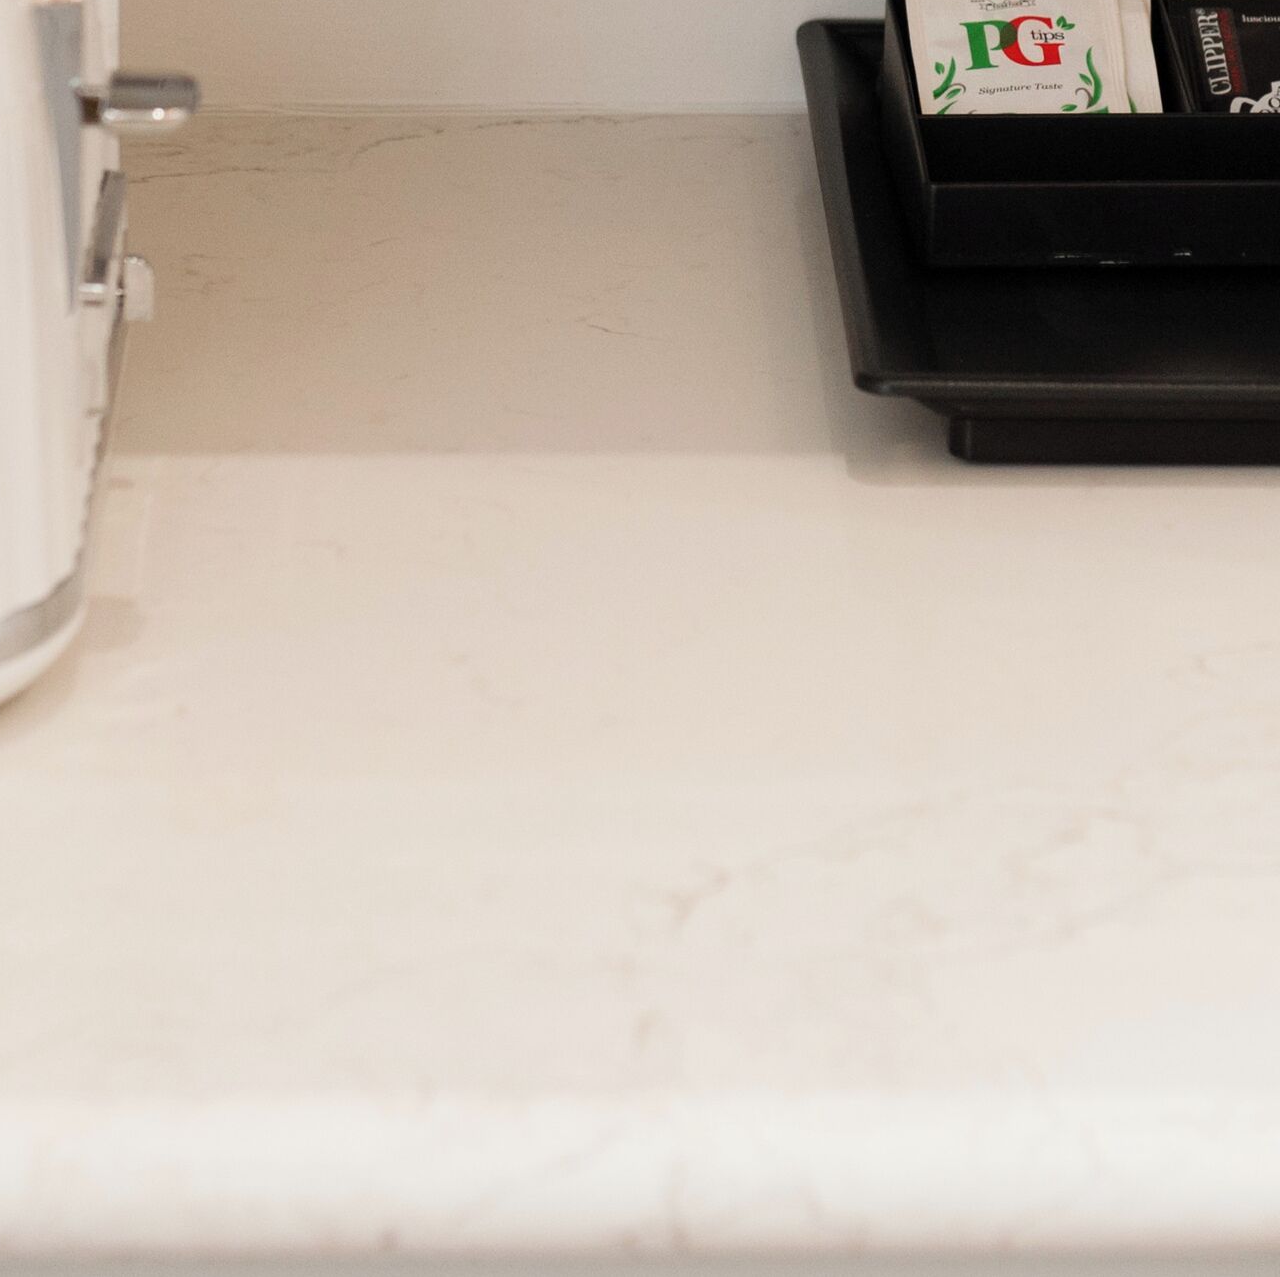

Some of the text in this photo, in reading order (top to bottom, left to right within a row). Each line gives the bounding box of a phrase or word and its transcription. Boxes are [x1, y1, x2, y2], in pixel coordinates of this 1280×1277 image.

[960, 15, 1065, 71] PG tips
[978, 82, 1064, 96] Signature Taste
